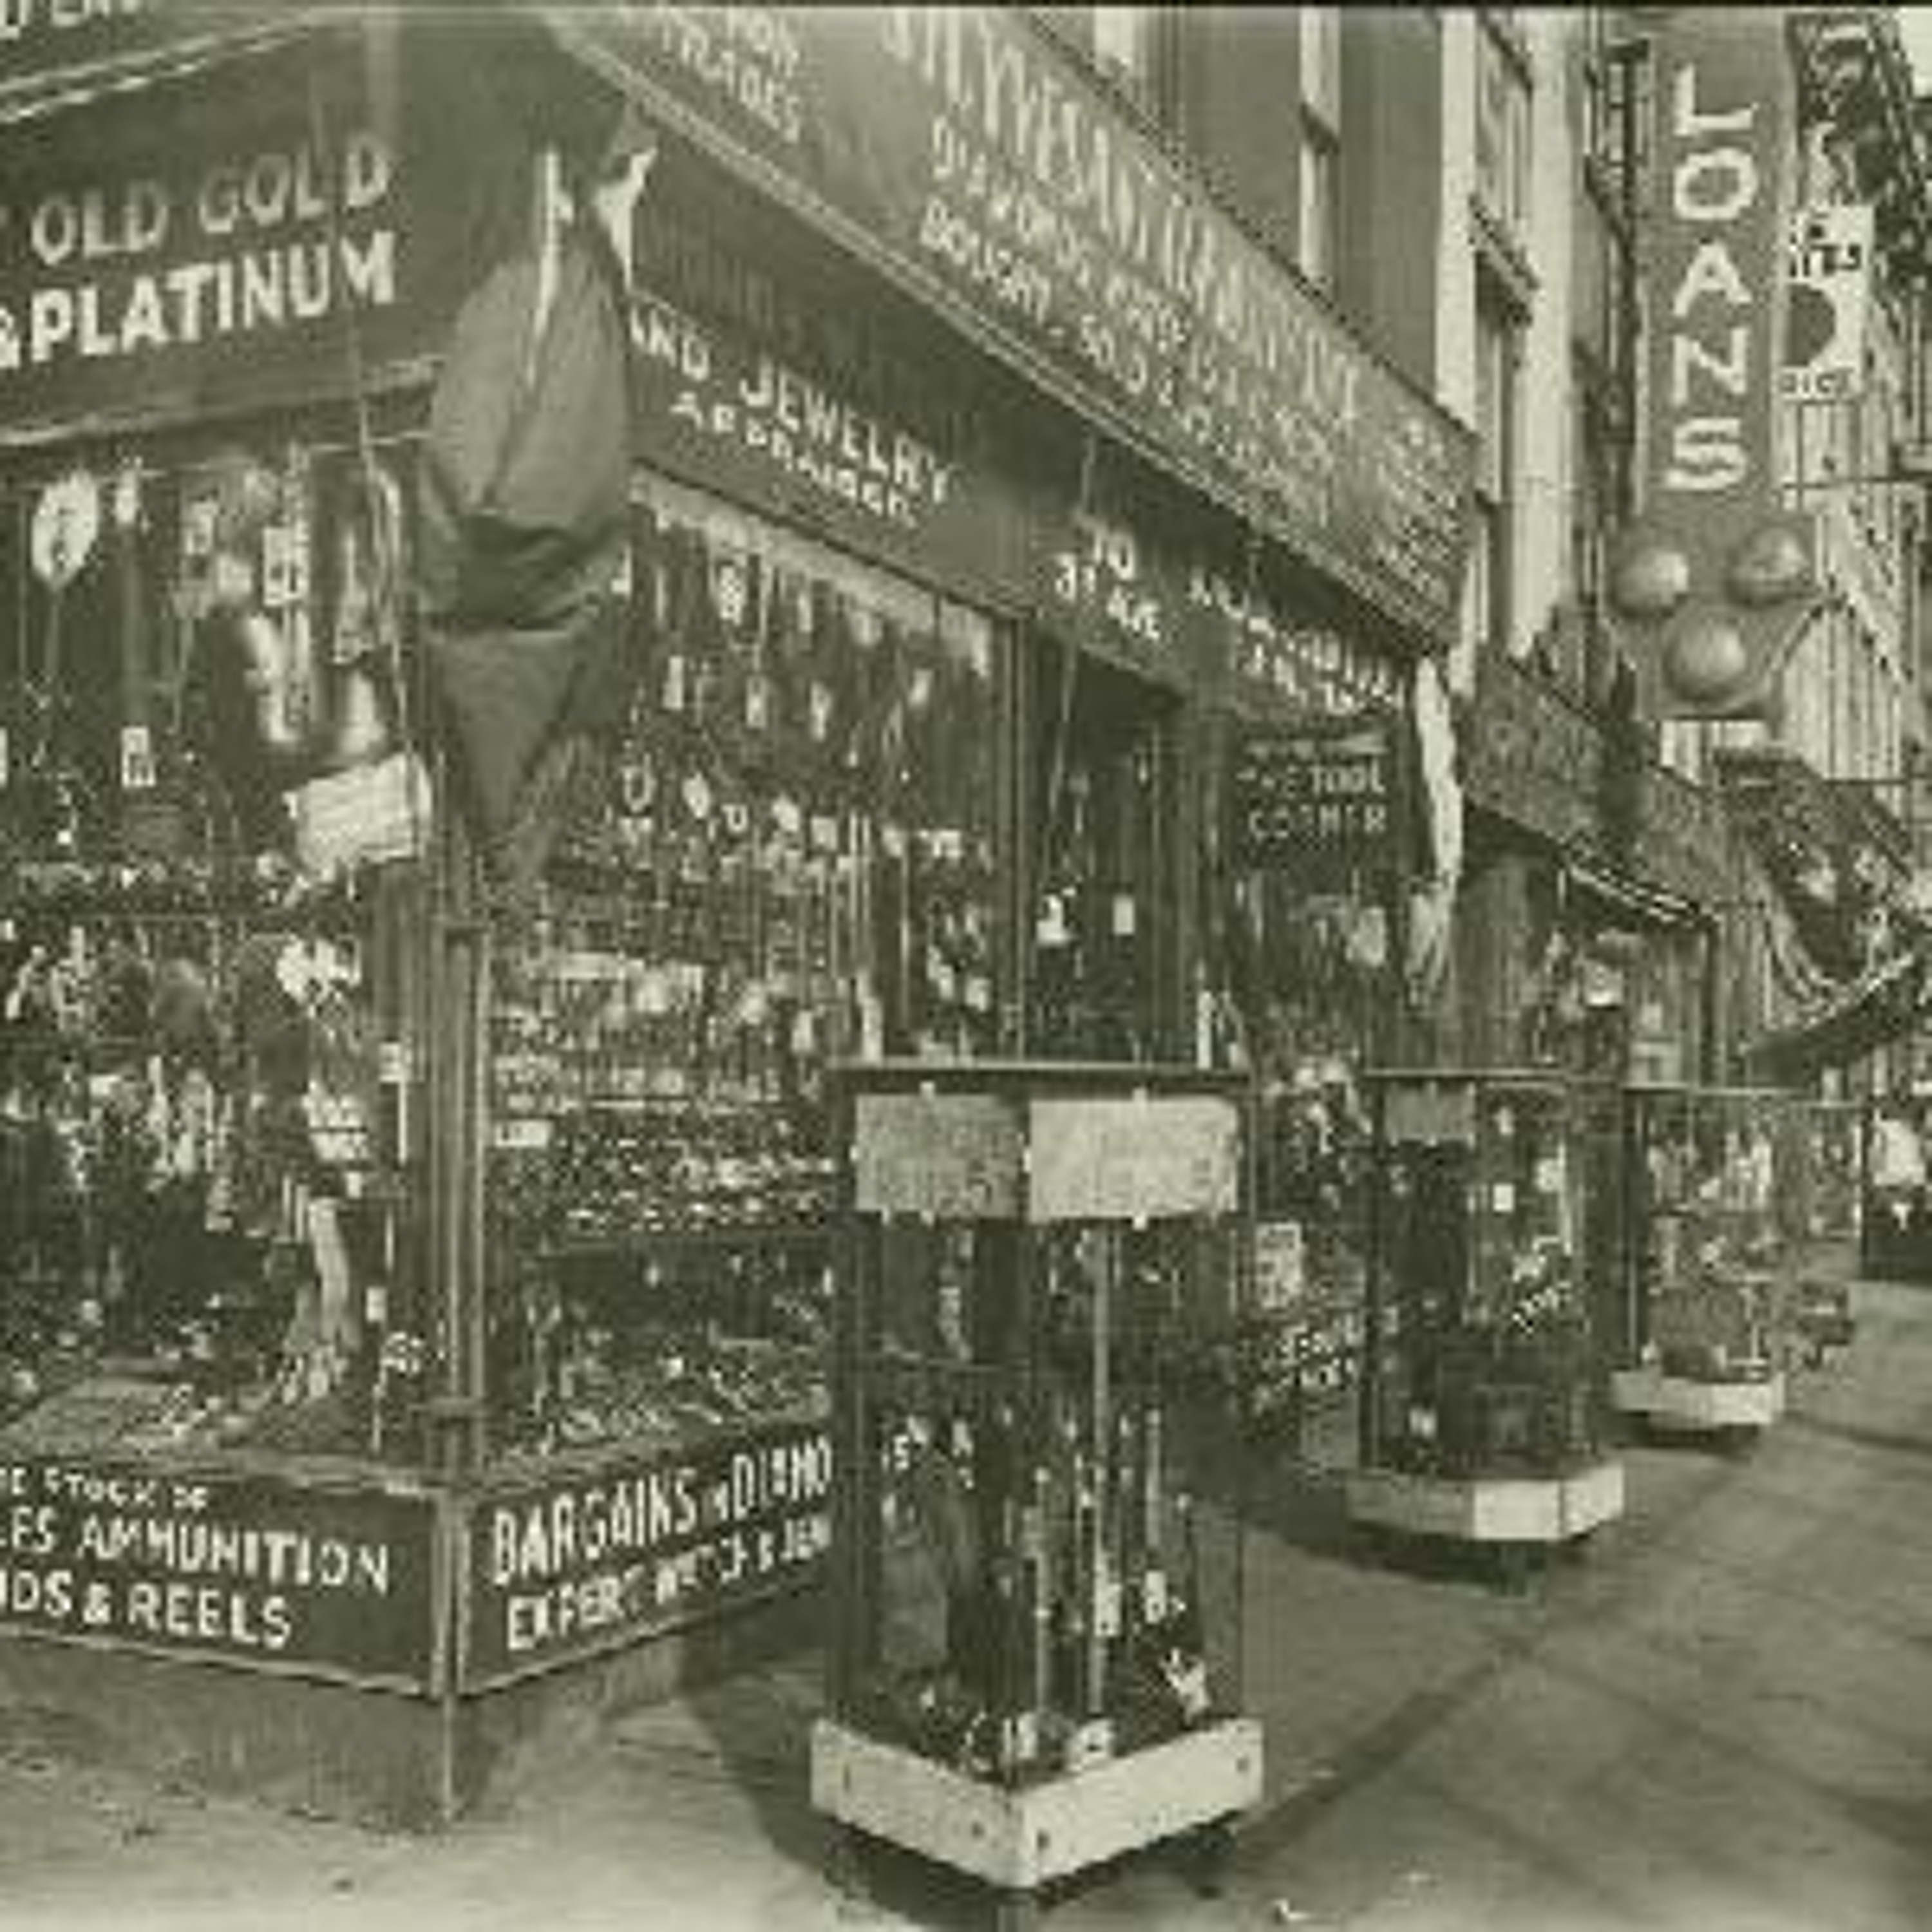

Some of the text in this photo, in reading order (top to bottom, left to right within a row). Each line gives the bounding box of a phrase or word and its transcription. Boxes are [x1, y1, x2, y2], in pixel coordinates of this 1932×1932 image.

[32, 131, 390, 265] OLD GOLD
[31, 230, 395, 363] PLATINUM
[1668, 64, 1758, 489] LOANS
[739, 355, 960, 504] JEWELRY
[44, 1467, 158, 1508] STOCK
[493, 1470, 697, 1587] BARGAINS
[76, 1513, 389, 1596] AMMUNITION
[82, 1582, 112, 1625] &
[128, 1582, 292, 1649] REELS
